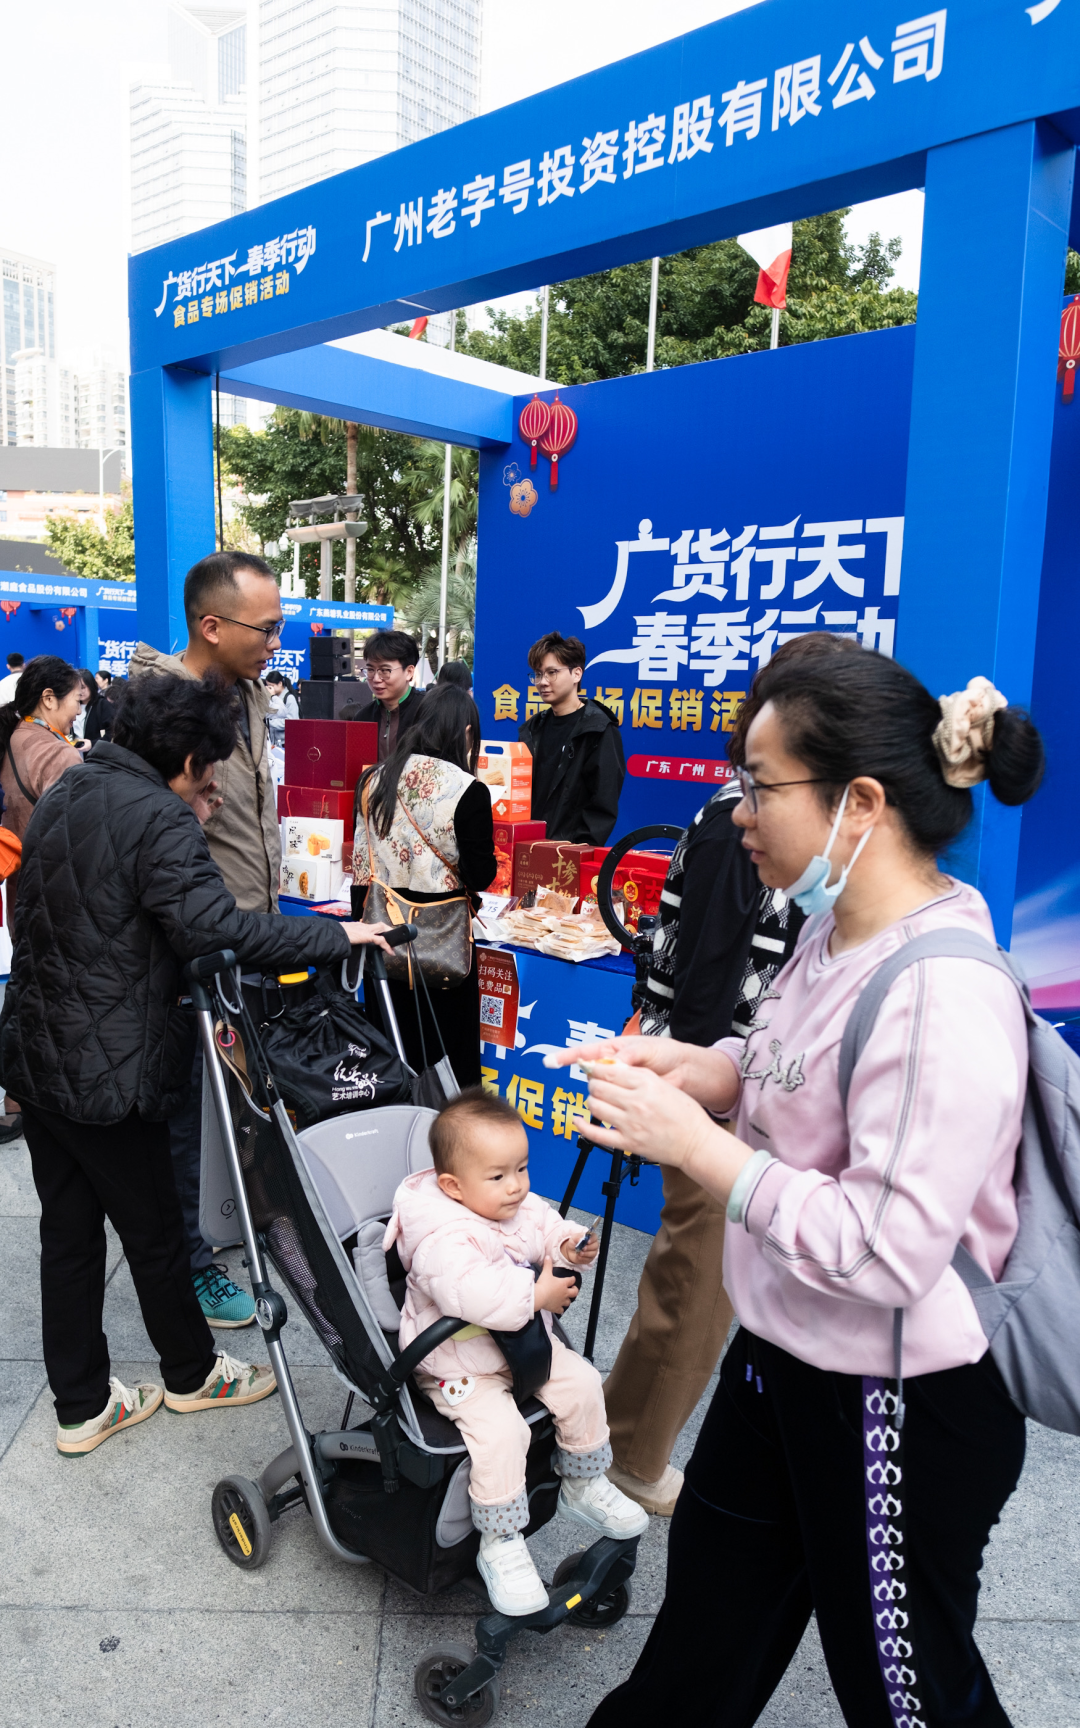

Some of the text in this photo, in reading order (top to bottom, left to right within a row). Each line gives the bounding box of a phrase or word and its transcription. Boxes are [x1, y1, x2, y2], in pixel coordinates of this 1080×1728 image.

[361, 8, 948, 263] 广州老字号投资控股有限公司
[172, 269, 290, 329] 食品专场促销活动
[492, 683, 748, 733] 食品场促销活
[645, 760, 671, 774] 广东
[679, 763, 705, 777] 广州
[478, 964, 513, 982] 扫码关注
[331, 1089, 371, 1101] 艺术培训中心
